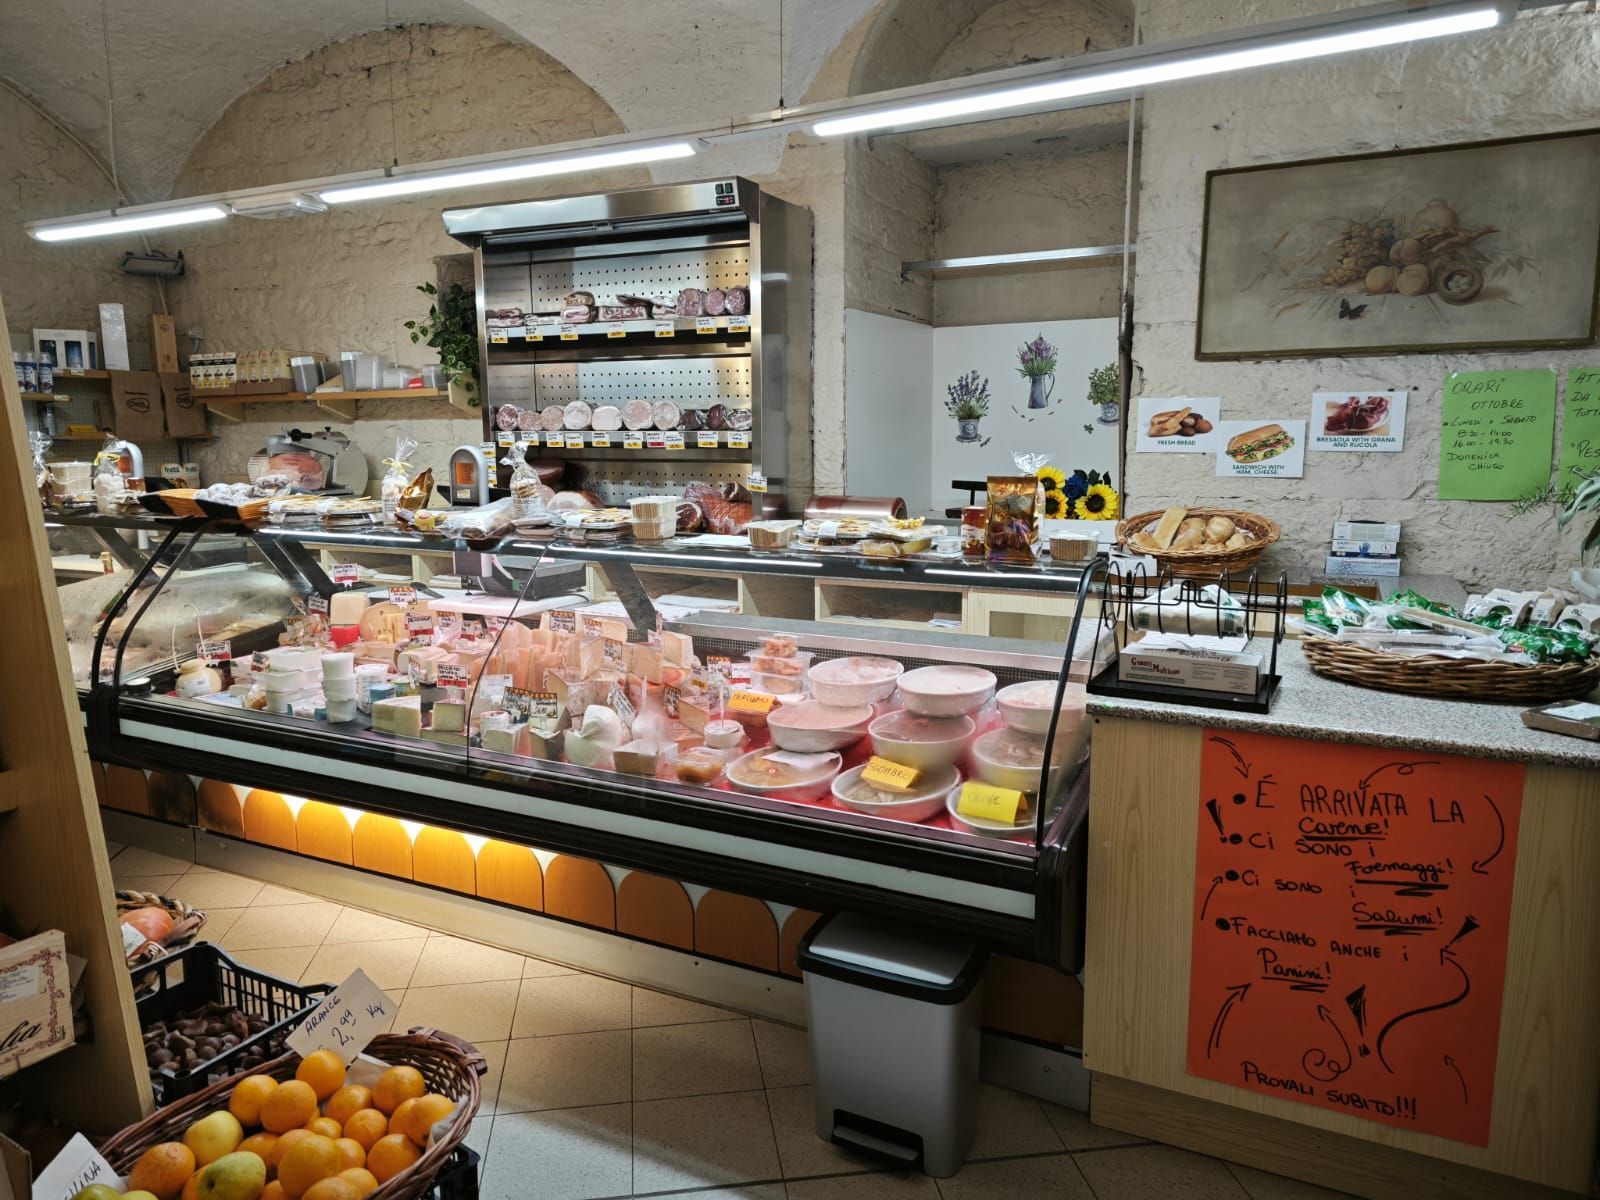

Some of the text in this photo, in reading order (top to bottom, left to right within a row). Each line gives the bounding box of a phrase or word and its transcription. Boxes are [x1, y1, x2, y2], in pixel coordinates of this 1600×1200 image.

[1471, 399, 1525, 411] OTTOBRE
[1300, 784, 1408, 817] ARRIVATA
[1429, 797, 1465, 824] LA
[1295, 838, 1352, 857] SONO
[1275, 878, 1322, 894] SONO
[1229, 916, 1317, 947] FACCIAMO
[1330, 940, 1382, 959] ANCHE
[1257, 947, 1333, 980] Panini!
[1240, 1060, 1315, 1096] PROVALI
